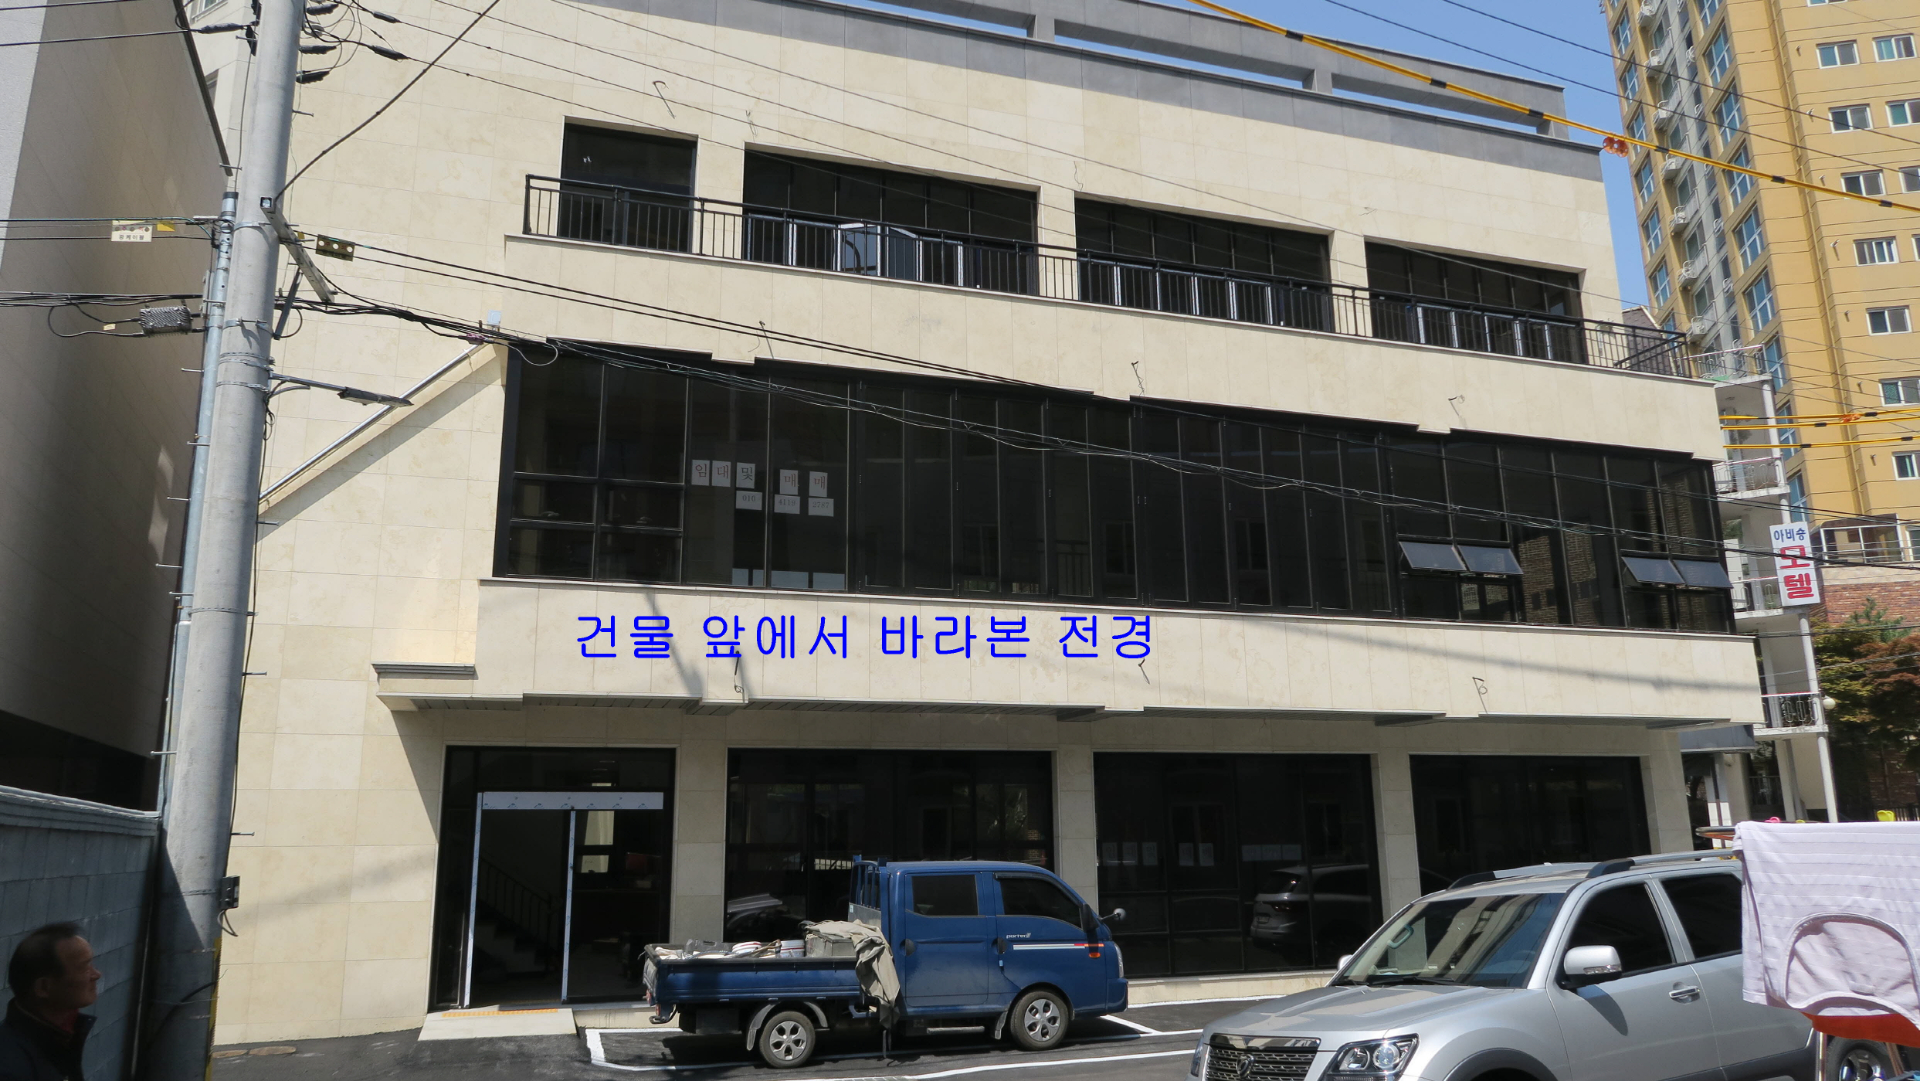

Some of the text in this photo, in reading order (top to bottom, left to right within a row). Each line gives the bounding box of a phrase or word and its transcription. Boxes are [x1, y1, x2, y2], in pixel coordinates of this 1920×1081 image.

[741, 466, 754, 481] 및
[742, 494, 756, 502] 010
[812, 501, 830, 509] 2787
[1779, 545, 1815, 599] 모텔
